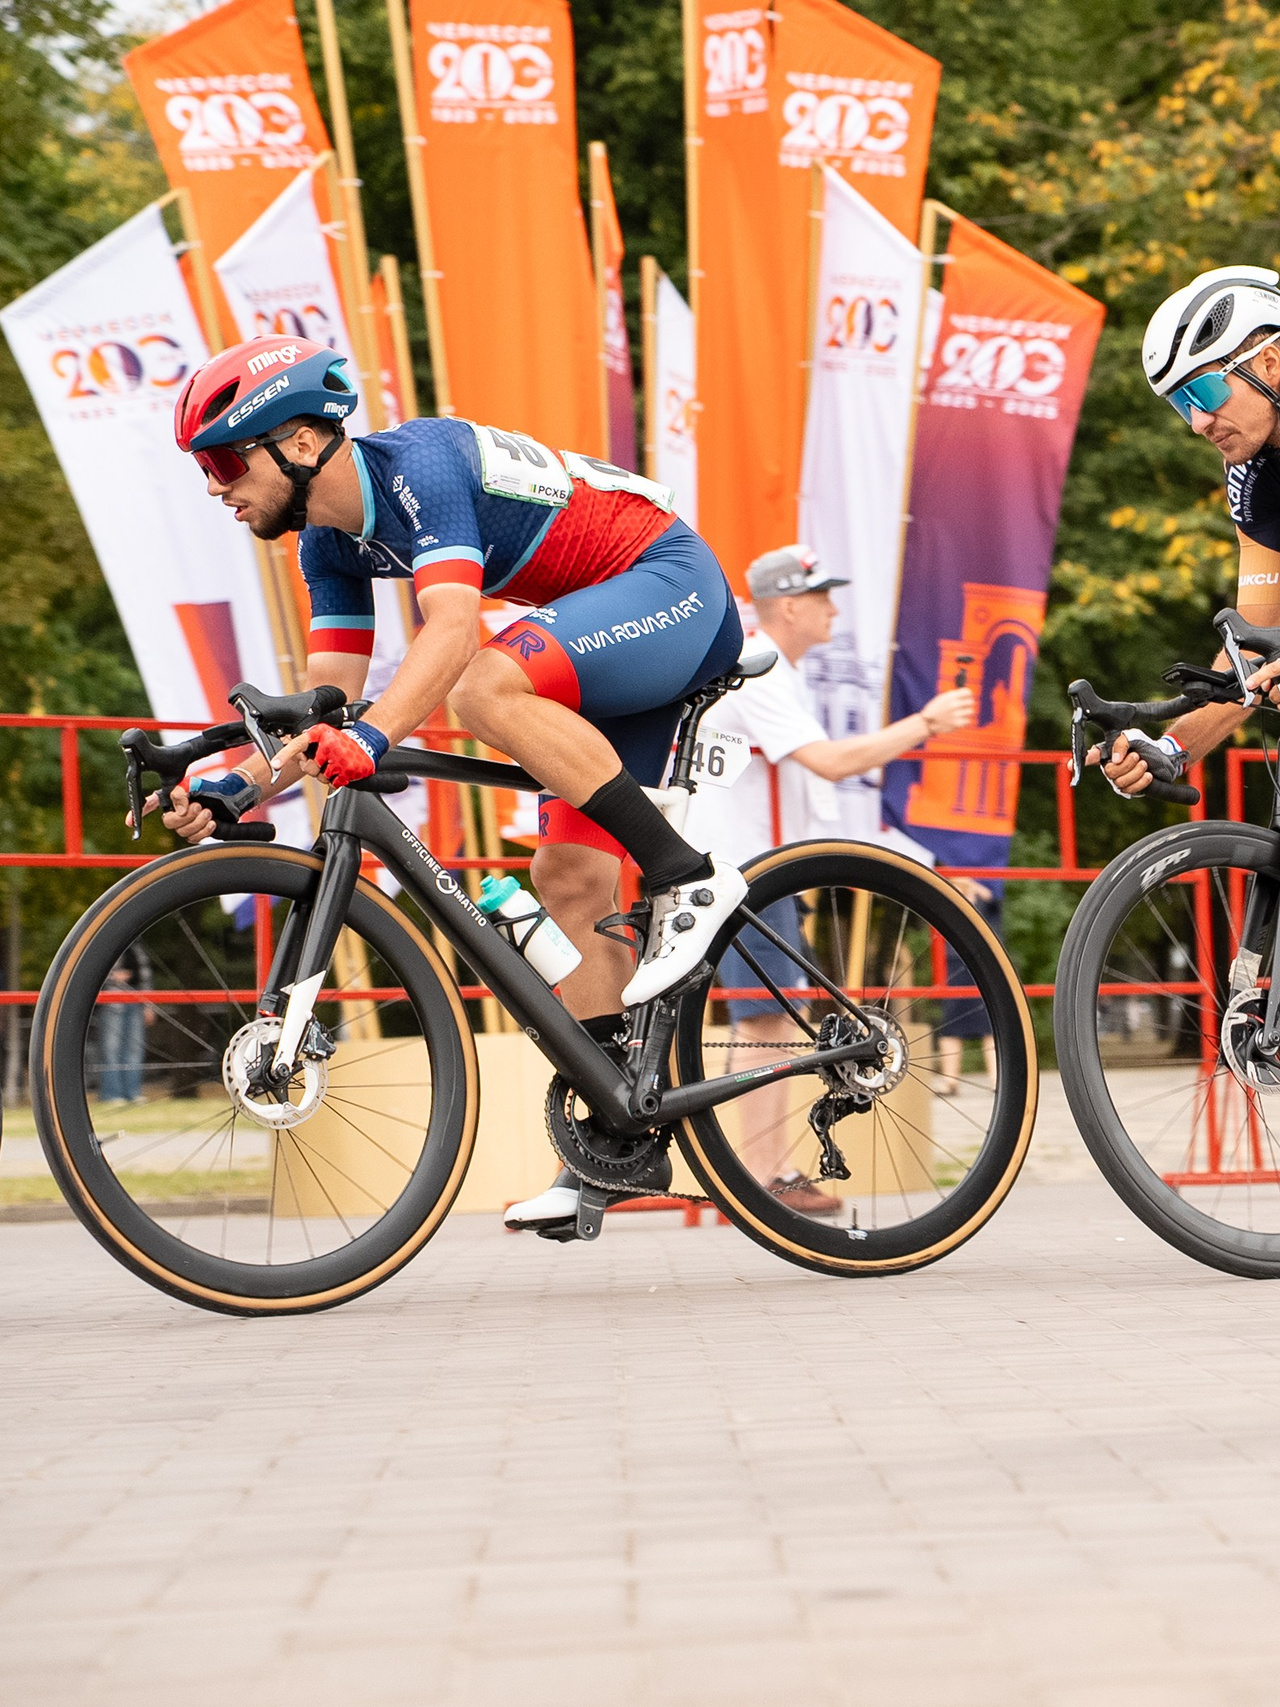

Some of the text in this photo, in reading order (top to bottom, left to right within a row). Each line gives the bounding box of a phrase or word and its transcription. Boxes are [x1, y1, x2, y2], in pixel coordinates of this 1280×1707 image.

[227, 375, 291, 428] ESSEN
[402, 485, 422, 514] BANK
[537, 484, 567, 499] РСХБ
[1238, 572, 1280, 588] икси
[568, 591, 705, 655] VIVA ROVAR ART
[720, 733, 743, 745] РСХБ
[691, 742, 726, 777] 46
[401, 829, 487, 928] OFFICINE MATTIO
